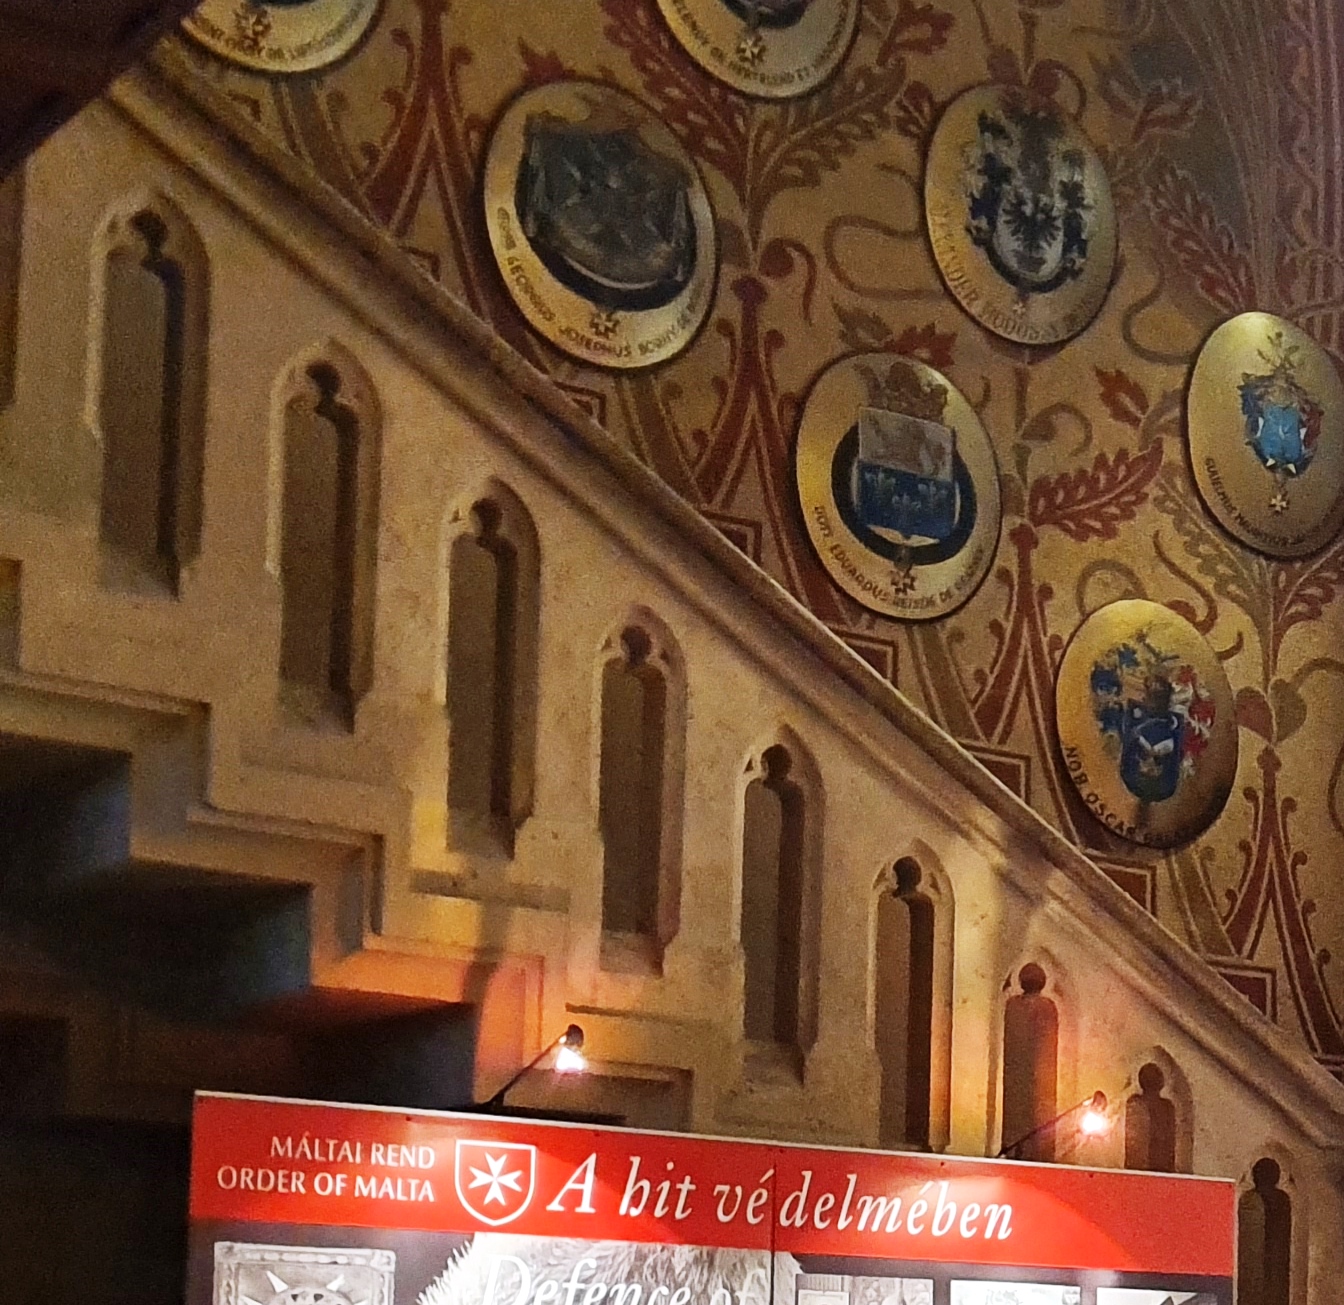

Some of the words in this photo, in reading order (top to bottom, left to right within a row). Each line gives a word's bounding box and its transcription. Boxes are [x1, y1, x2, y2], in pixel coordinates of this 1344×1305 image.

[270, 1131, 362, 1164] MÁLTAI
[370, 1143, 435, 1168] REND
[217, 1166, 306, 1194] ORDER
[314, 1173, 347, 1196] OF
[354, 1175, 435, 1203] MALTA
[546, 1153, 597, 1213] A
[619, 1156, 696, 1220] hit
